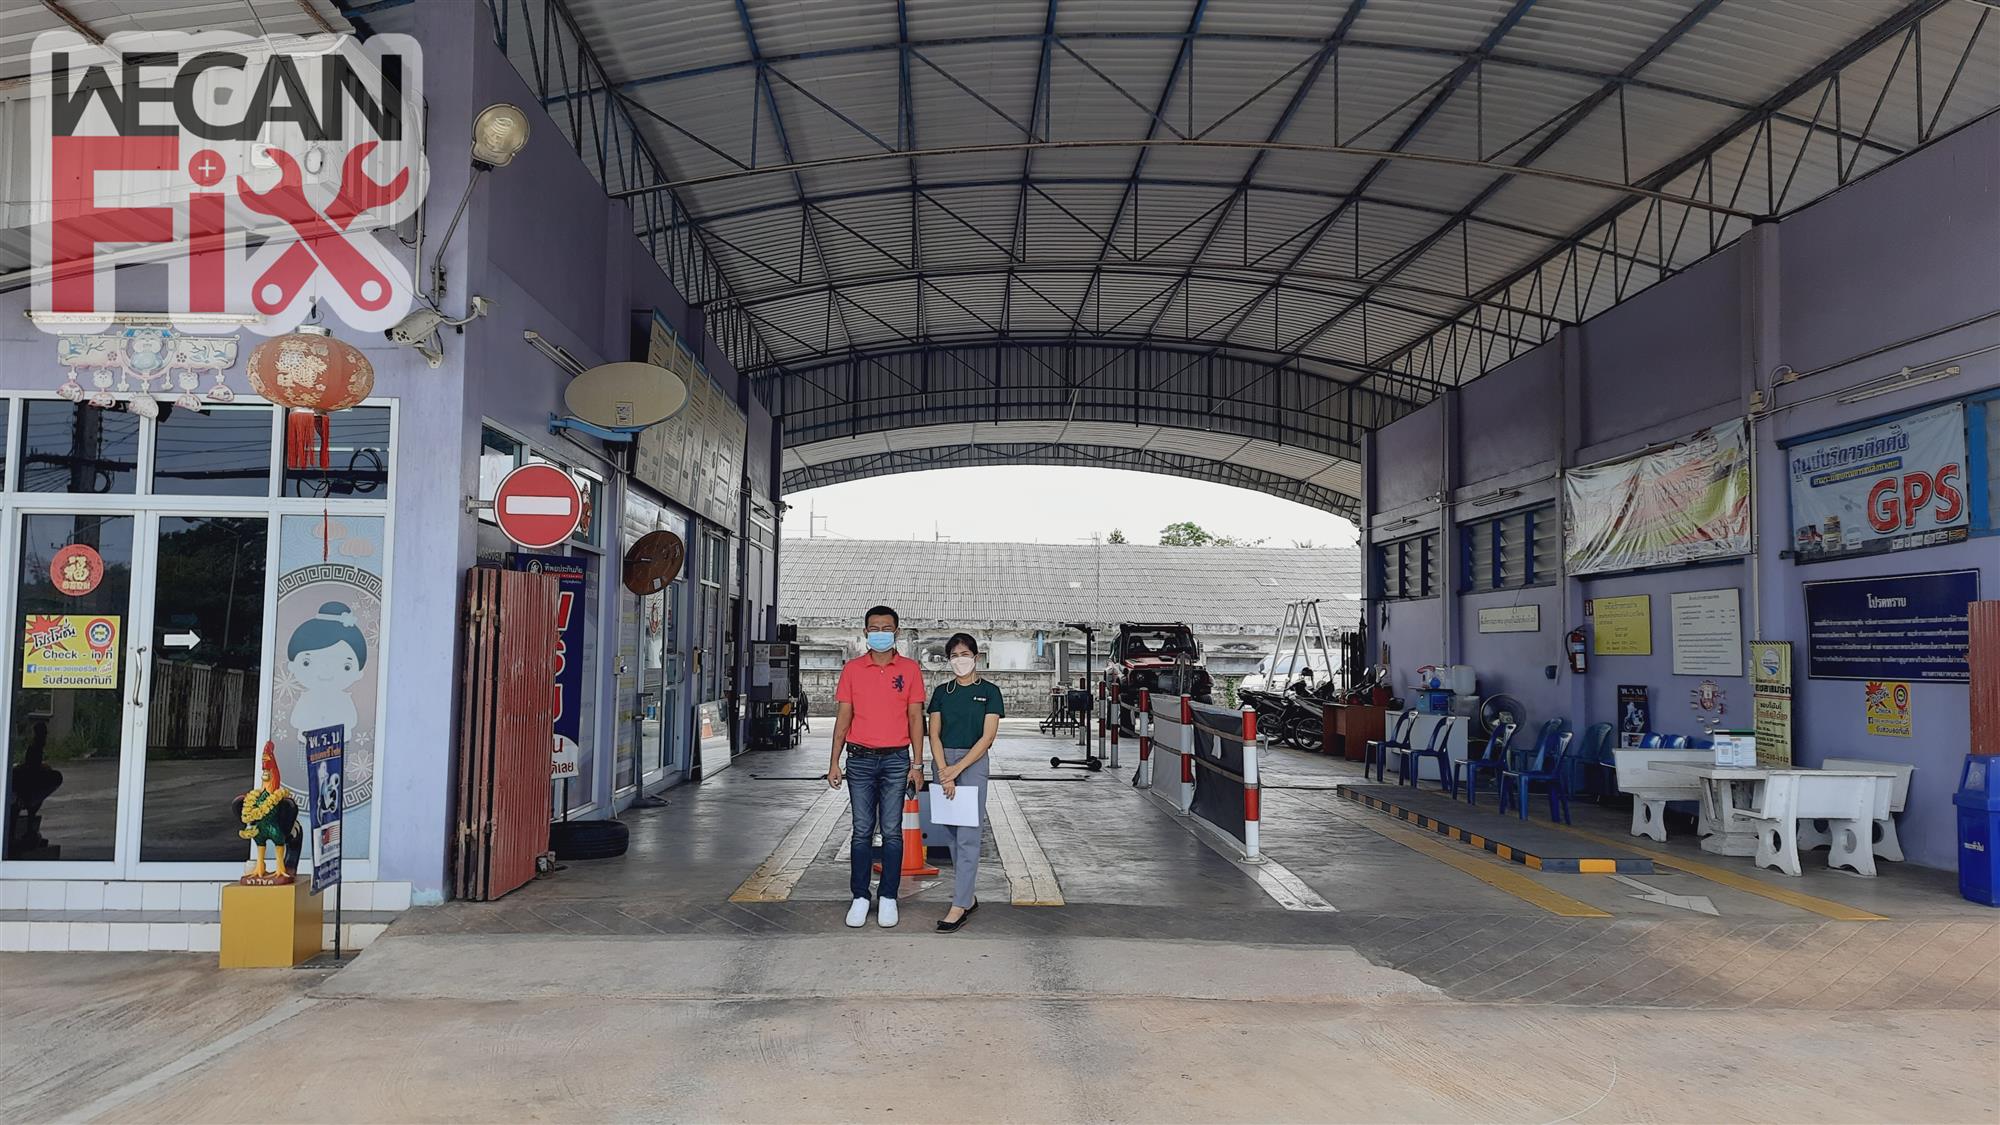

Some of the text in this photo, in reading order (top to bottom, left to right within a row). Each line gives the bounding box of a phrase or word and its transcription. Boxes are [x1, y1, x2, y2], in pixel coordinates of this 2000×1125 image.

[1867, 463, 1963, 534] GPS
[1866, 593, 1907, 609] โปรดทราบ
[32, 618, 77, 649] โปรโมชั่น
[43, 650, 77, 660] Check
